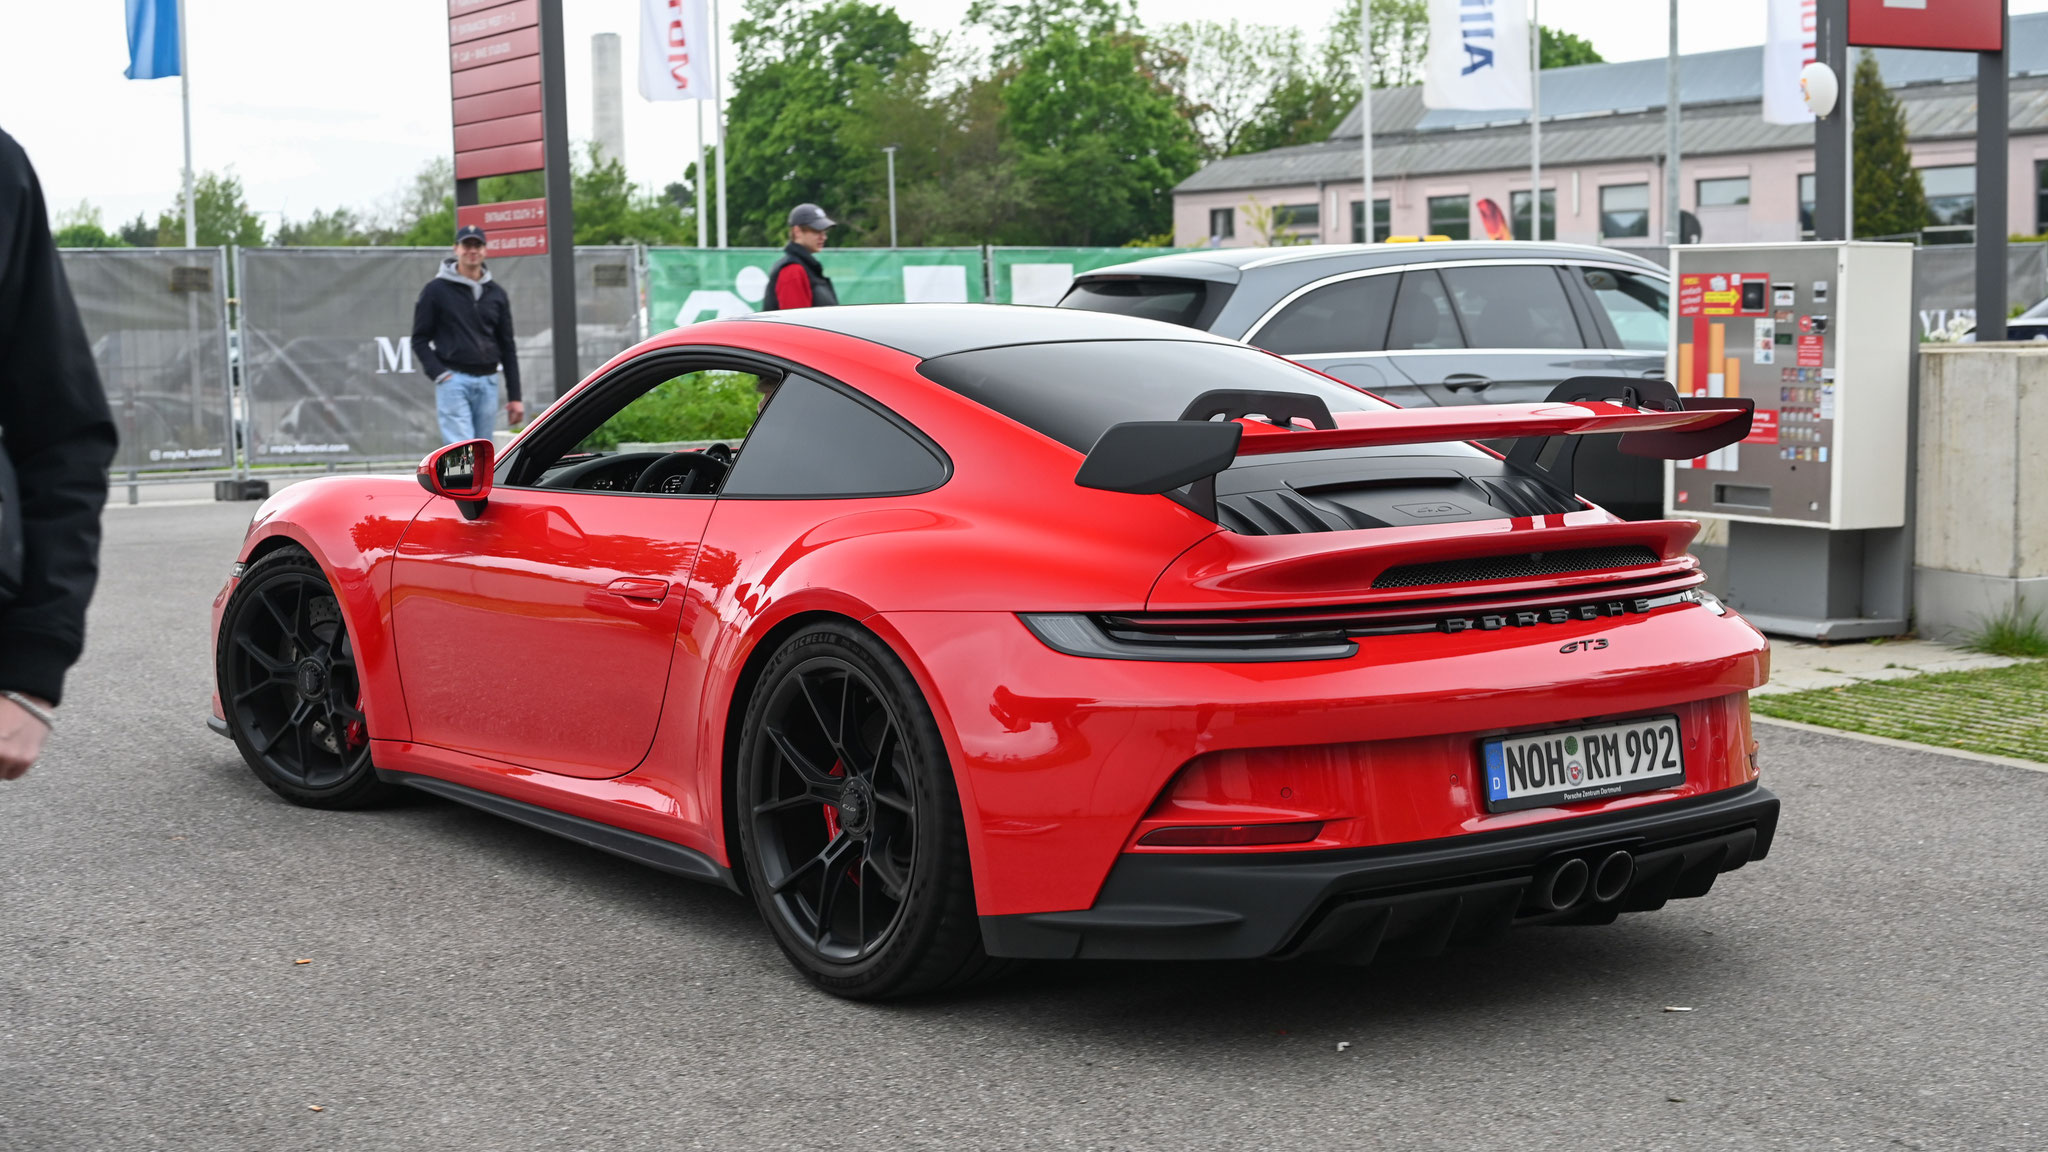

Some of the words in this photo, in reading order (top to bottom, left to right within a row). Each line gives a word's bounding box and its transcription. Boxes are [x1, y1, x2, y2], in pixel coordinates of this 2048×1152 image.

[1440, 598, 1650, 633] PORSCHE
[786, 633, 837, 656] MICHELIN
[1559, 638, 1609, 654] GT3
[1506, 739, 1566, 792] NOH
[1583, 732, 1622, 780] RM
[1625, 725, 1677, 774] 992
[1492, 776, 1501, 790] D
[1564, 792, 1582, 801] Porsche
[1582, 789, 1600, 798] Zentrum
[1600, 785, 1622, 795] Dortmund
